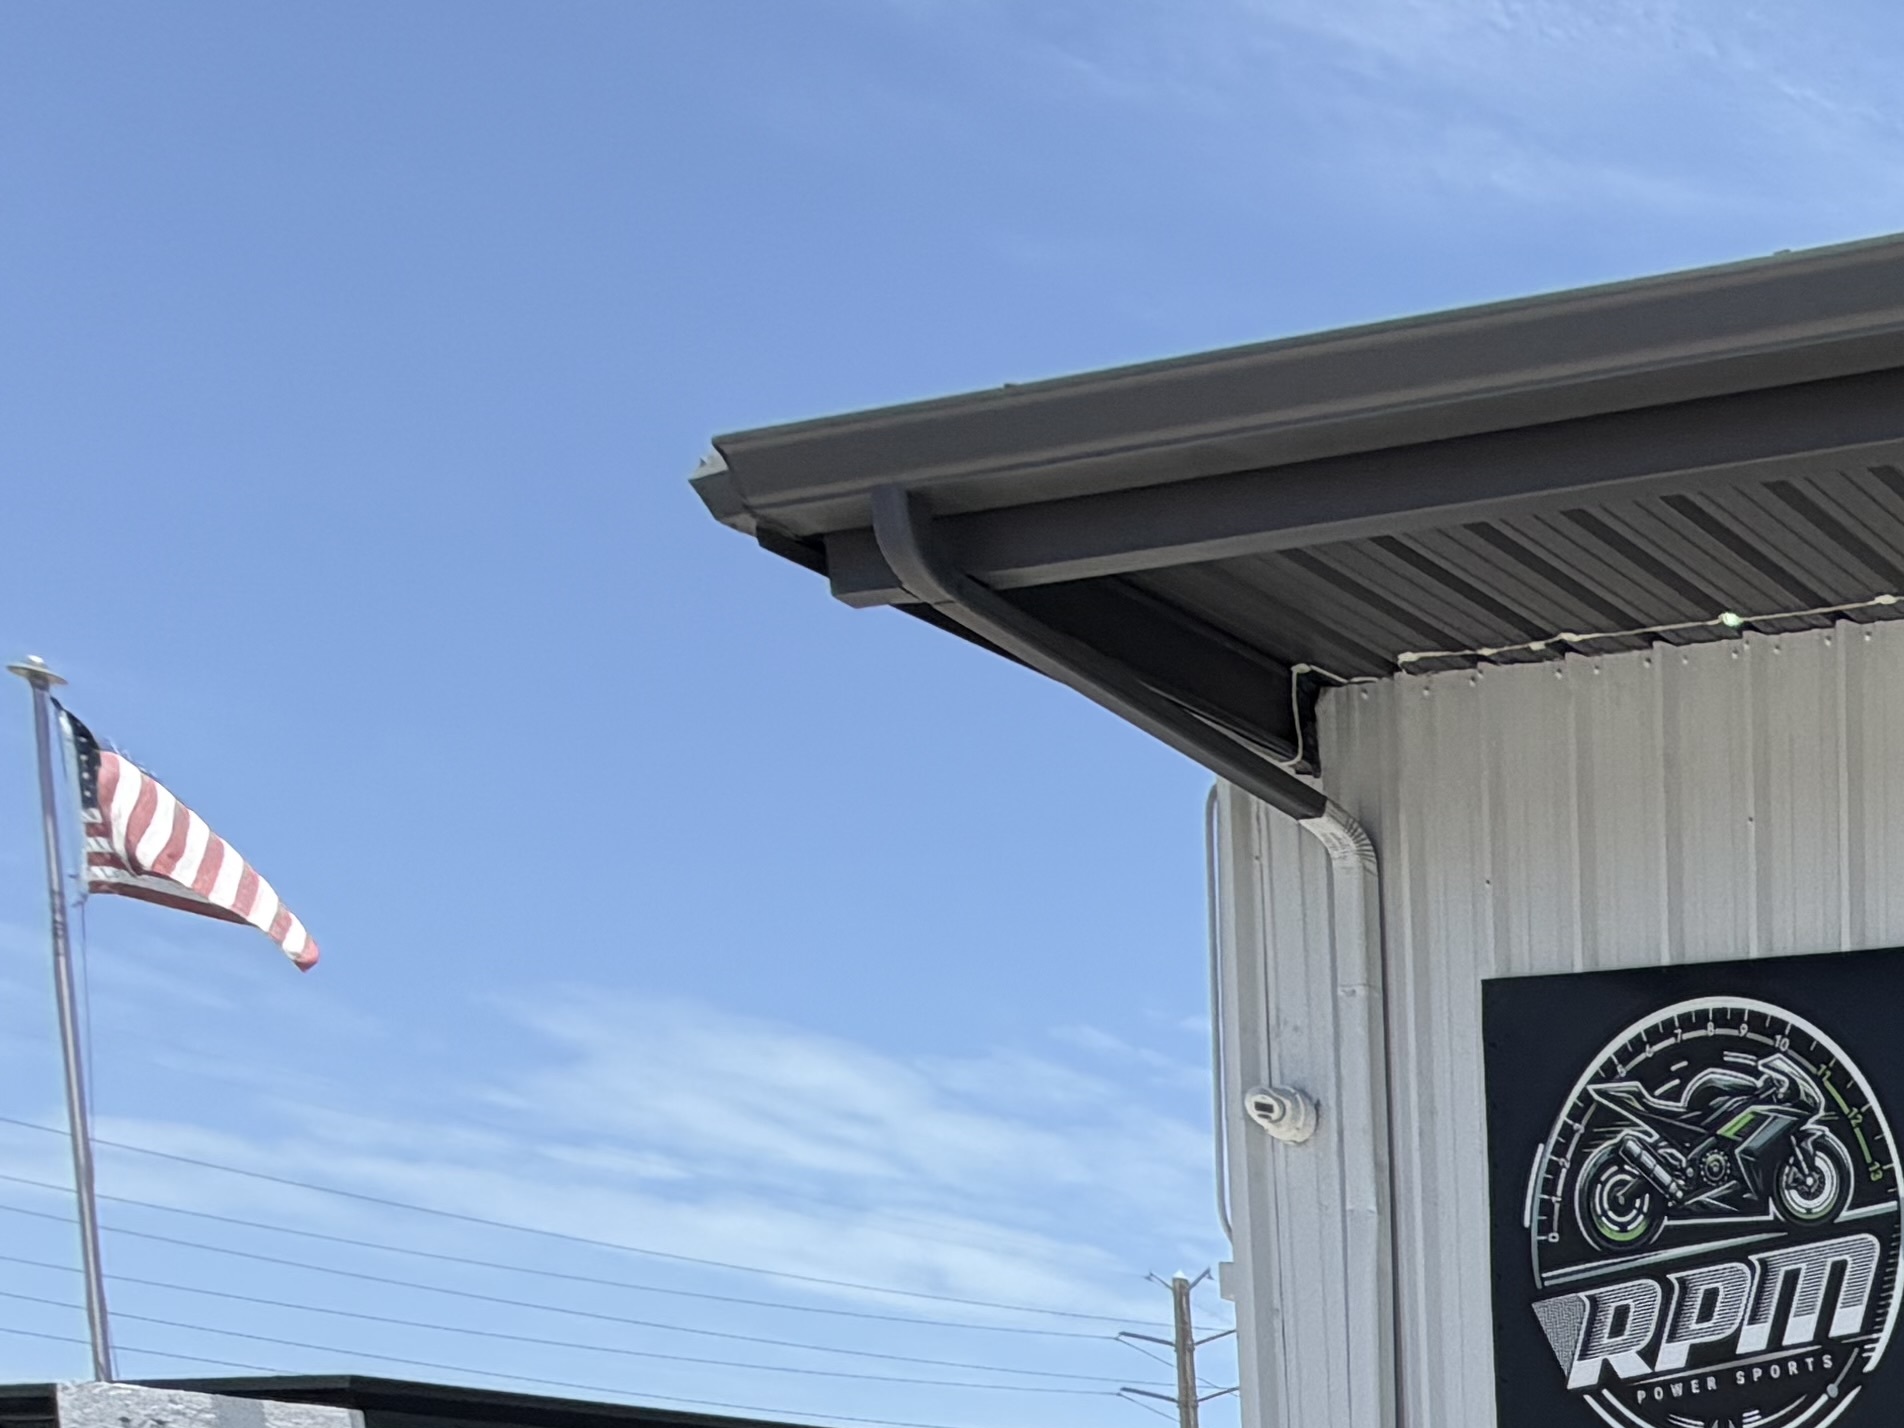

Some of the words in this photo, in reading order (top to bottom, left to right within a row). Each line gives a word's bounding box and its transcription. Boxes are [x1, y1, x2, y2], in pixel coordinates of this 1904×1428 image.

[1566, 1233, 1882, 1390] RPM
[1636, 1376, 1718, 1405] POWER
[1735, 1354, 1834, 1385] SPORTS
